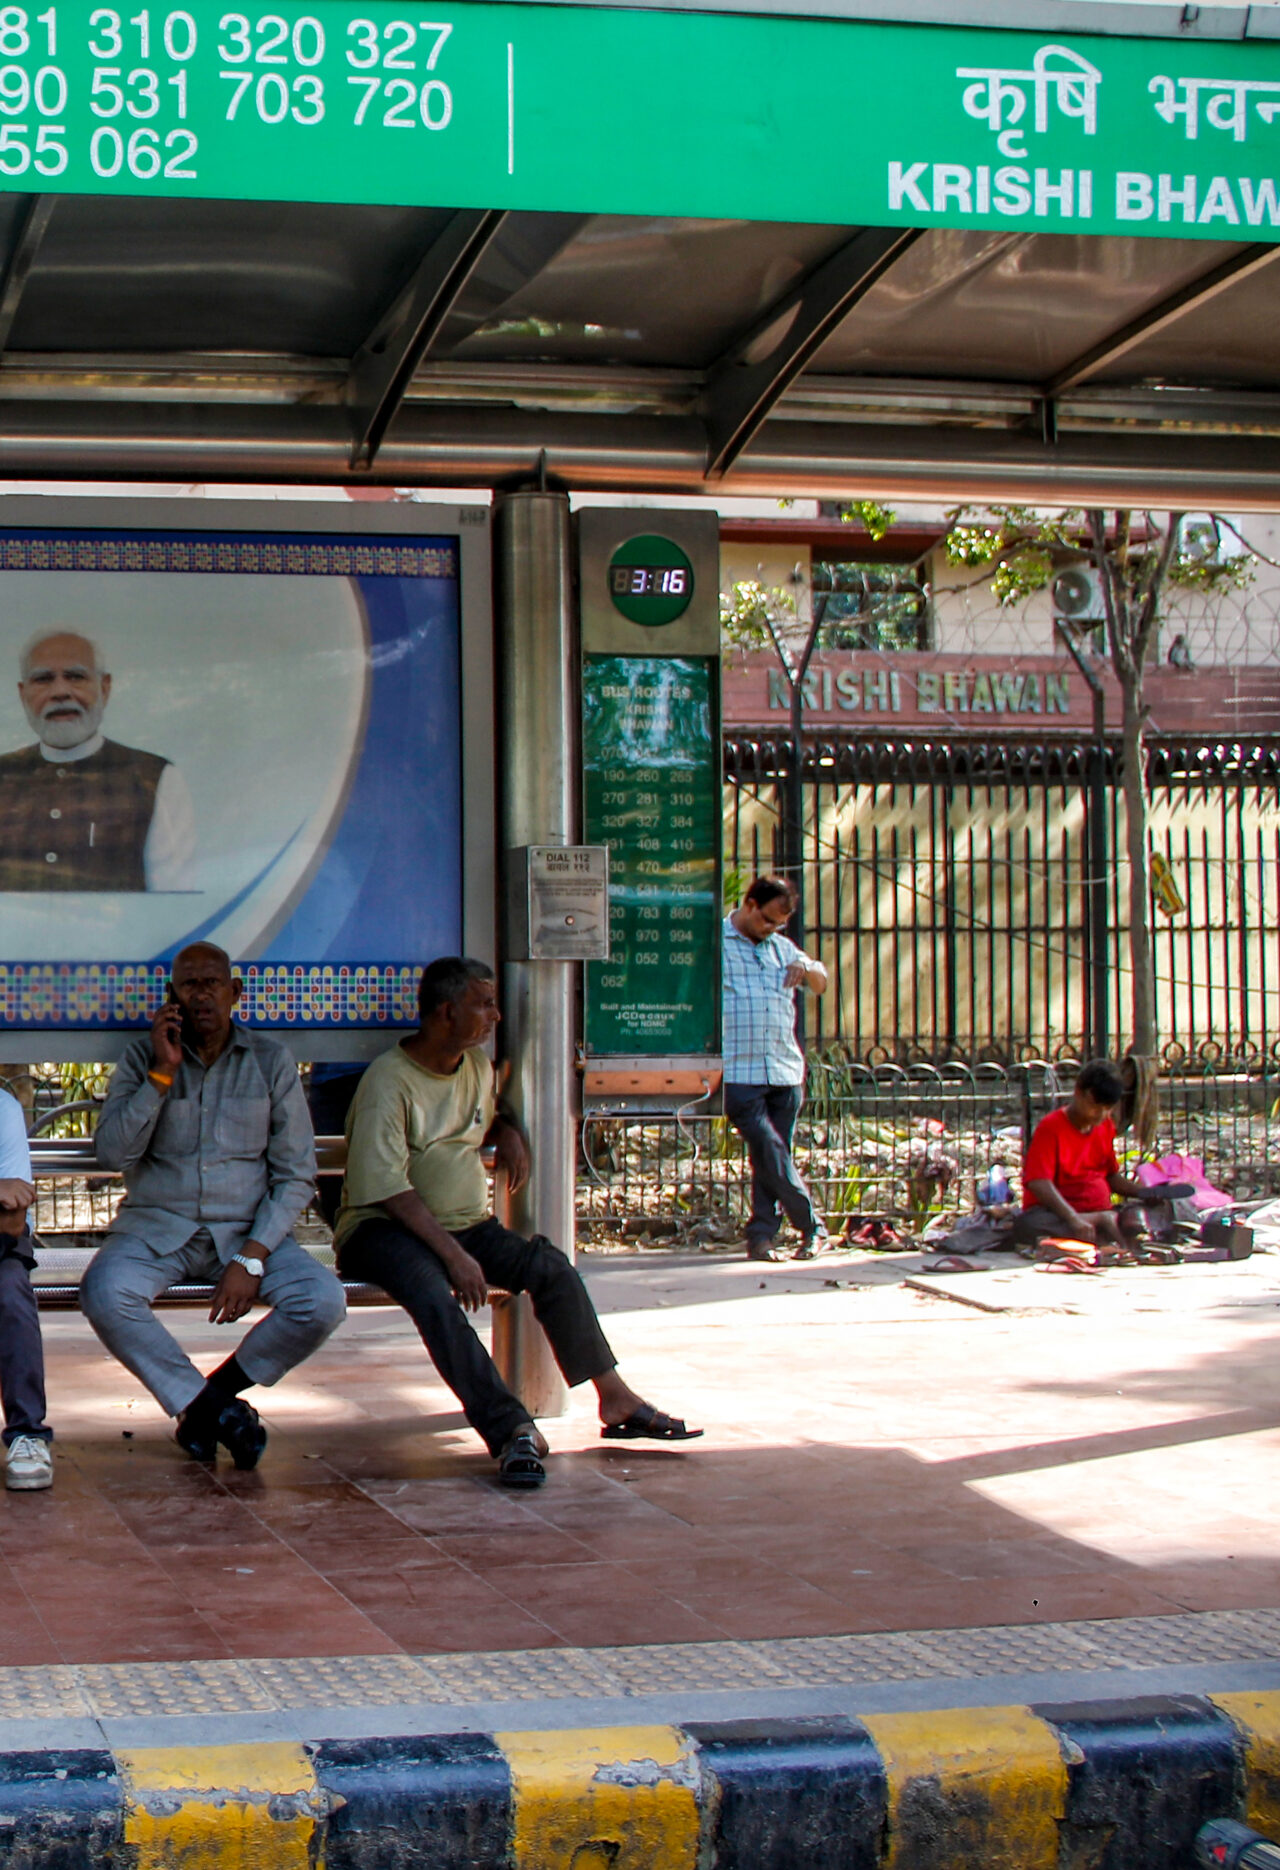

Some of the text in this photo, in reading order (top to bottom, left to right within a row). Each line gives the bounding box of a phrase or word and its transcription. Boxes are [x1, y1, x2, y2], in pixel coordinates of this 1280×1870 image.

[89, 9, 197, 60] 310
[218, 13, 325, 66] 320
[346, 19, 453, 70] 327
[90, 67, 186, 118] 531
[220, 71, 325, 124] 703
[348, 76, 452, 130] 720
[956, 44, 1102, 158] कृषि
[90, 126, 198, 178] 062
[888, 161, 1280, 227] KRISHI BHAW
[631, 569, 685, 593] 3:16
[601, 685, 630, 698] BUS
[767, 669, 1070, 714] KRISHI BHAWAN
[602, 770, 625, 782] 190
[636, 770, 659, 782] 260
[602, 792, 694, 805] 270 281 310
[602, 816, 694, 828] 320 327 384
[636, 838, 659, 850] 408
[670, 838, 694, 850] 410
[546, 853, 590, 862] DIAL 112
[608, 861, 625, 873] 30
[636, 861, 659, 873] 470
[608, 884, 625, 895] 90
[608, 907, 625, 919] 20
[636, 907, 659, 919] 783
[670, 907, 694, 919] 860
[608, 930, 625, 941] 30
[636, 930, 659, 941] 970
[670, 930, 694, 941] 994
[601, 953, 694, 964] 43 052 055
[602, 975, 625, 987] 062
[615, 1012, 676, 1020] JCDecaux
